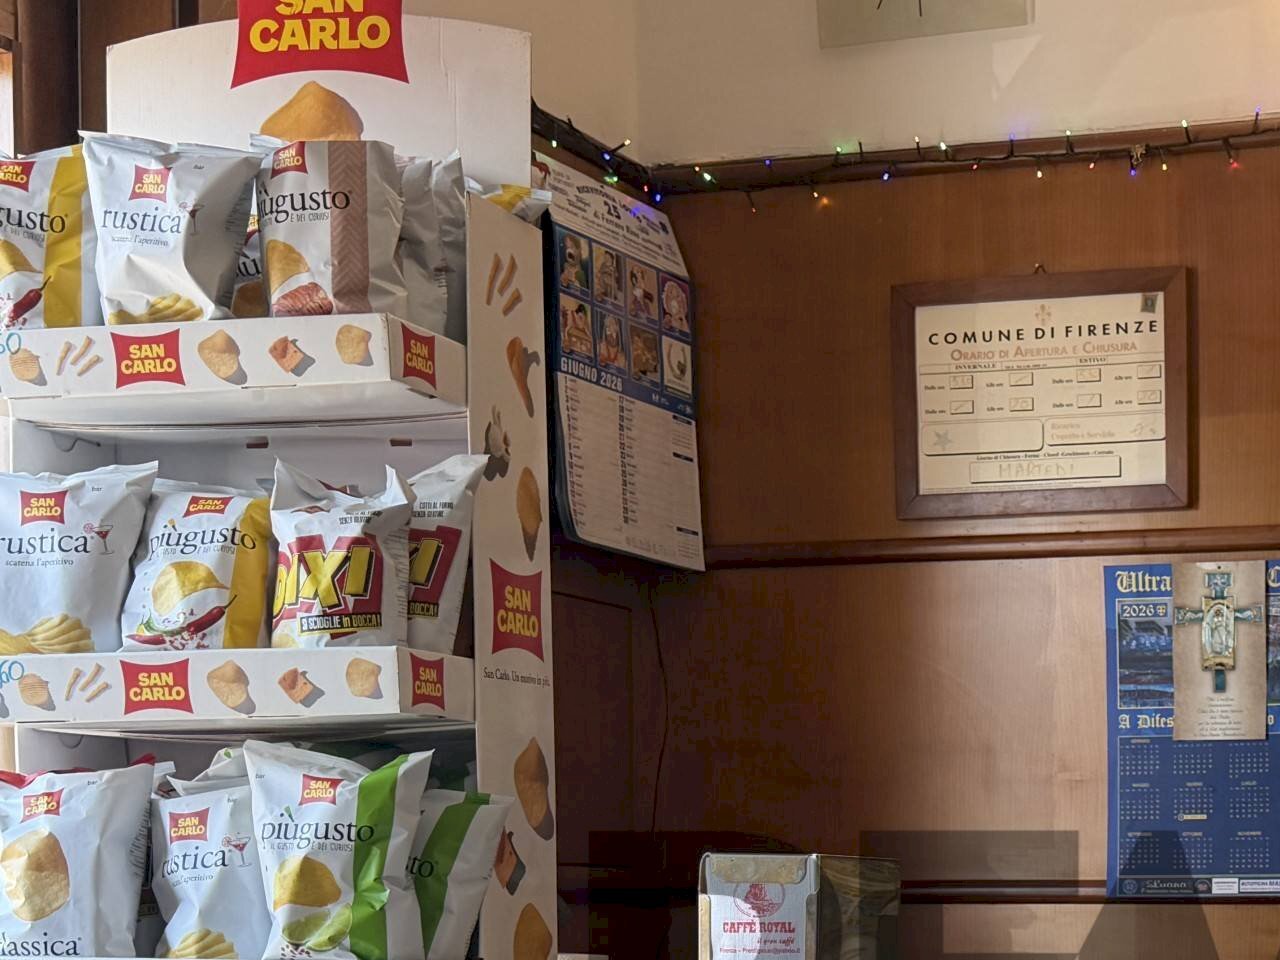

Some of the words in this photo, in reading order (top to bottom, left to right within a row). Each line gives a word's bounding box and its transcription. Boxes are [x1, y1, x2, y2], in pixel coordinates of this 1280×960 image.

[249, 15, 390, 53] CARLO
[280, 148, 296, 158] SAN
[275, 156, 303, 169] CARLO
[143, 174, 161, 185] SAN
[135, 183, 166, 196] CARLO
[103, 206, 183, 234] rustica
[928, 328, 1025, 346] COMUNE
[1035, 326, 1055, 340] DI
[1065, 320, 1158, 338] FIRENZE
[129, 343, 165, 359] SAN
[410, 339, 429, 359] SAN
[1014, 342, 1068, 359] APERTURA
[1082, 340, 1138, 355] CHIUSURA
[120, 358, 177, 374] CARLO
[406, 352, 434, 375] CARLO
[560, 357, 598, 382] GIUGNO
[30, 497, 55, 508] SAN
[190, 503, 225, 512] CARLO
[24, 506, 61, 518] CARLO
[1115, 571, 1173, 592] Ultra
[505, 585, 532, 612] SAN
[1122, 604, 1155, 618] 2026
[308, 614, 341, 629] SCIOGLIE
[498, 609, 538, 638] CARLO
[138, 672, 173, 687] SAN
[420, 667, 438, 681] SAN
[129, 686, 185, 702] CARLO
[415, 681, 442, 698] CARLO
[1137, 712, 1174, 728] Difes
[310, 780, 330, 790] SAN
[31, 795, 50, 806] SAN
[304, 788, 334, 799] CARLO
[177, 816, 199, 828] SAN
[261, 804, 375, 849] piùgusto
[171, 825, 205, 837] CARLO
[722, 918, 757, 934] CAFFÈ
[759, 921, 796, 934] ROYAL
